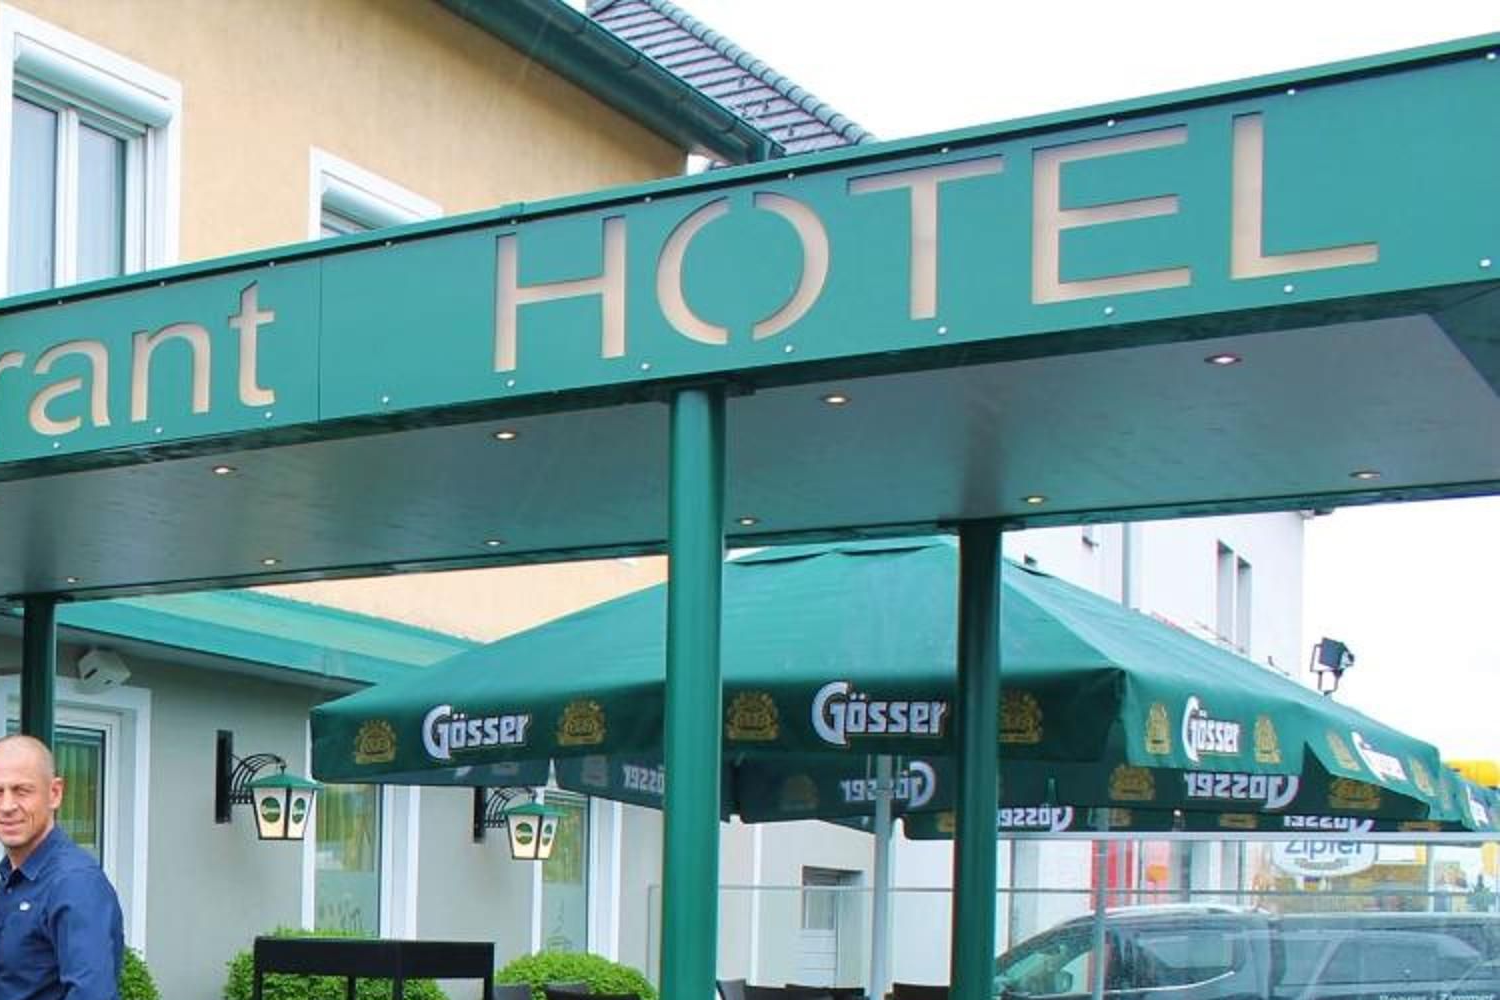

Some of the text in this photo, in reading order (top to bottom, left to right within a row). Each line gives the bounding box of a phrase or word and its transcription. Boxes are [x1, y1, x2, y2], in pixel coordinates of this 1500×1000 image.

[493, 112, 1378, 373] HOTEL
[422, 704, 530, 760] Gösser
[812, 681, 946, 745] Gösser
[1182, 696, 1241, 762] Gösser
